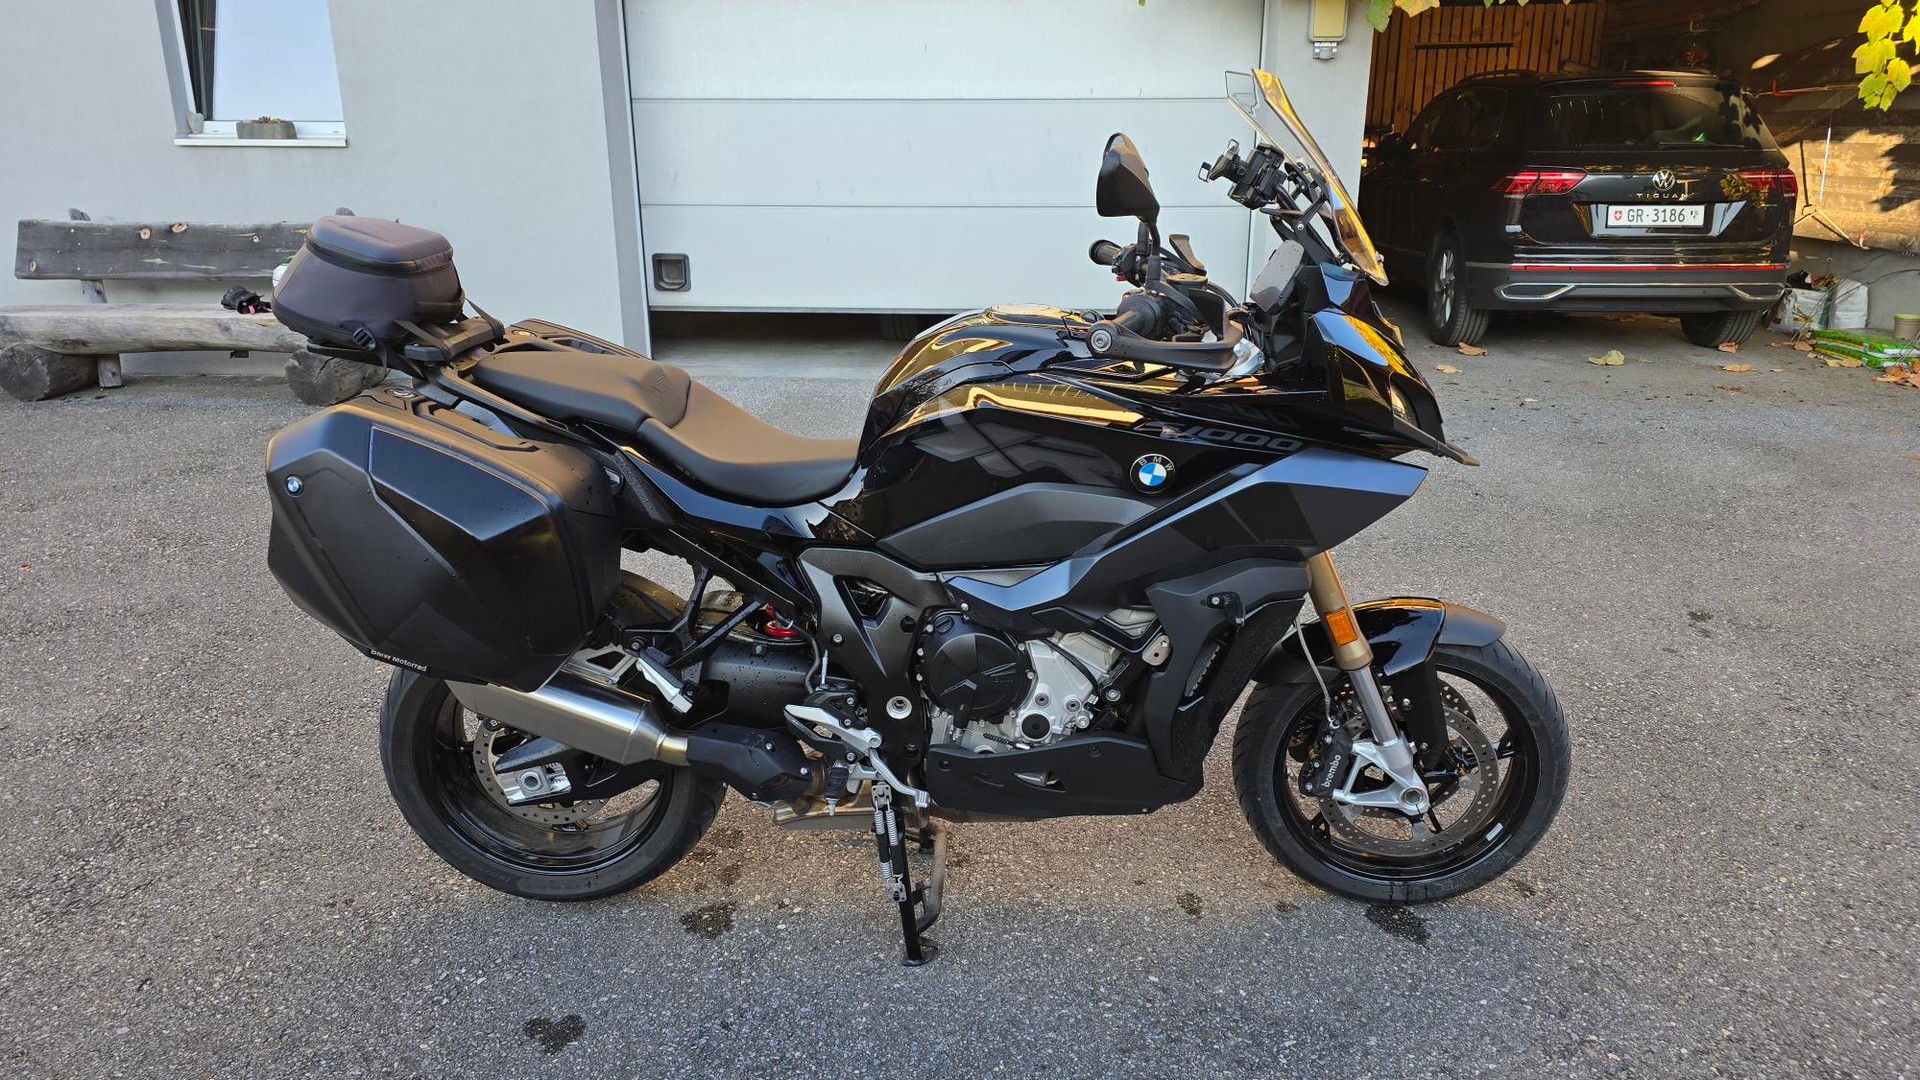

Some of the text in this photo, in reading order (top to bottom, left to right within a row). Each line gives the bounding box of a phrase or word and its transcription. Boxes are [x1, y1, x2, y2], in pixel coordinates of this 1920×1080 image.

[1138, 455, 1174, 472] BMW
[392, 656, 427, 672] Motorrad
[1322, 754, 1341, 788] brembo
